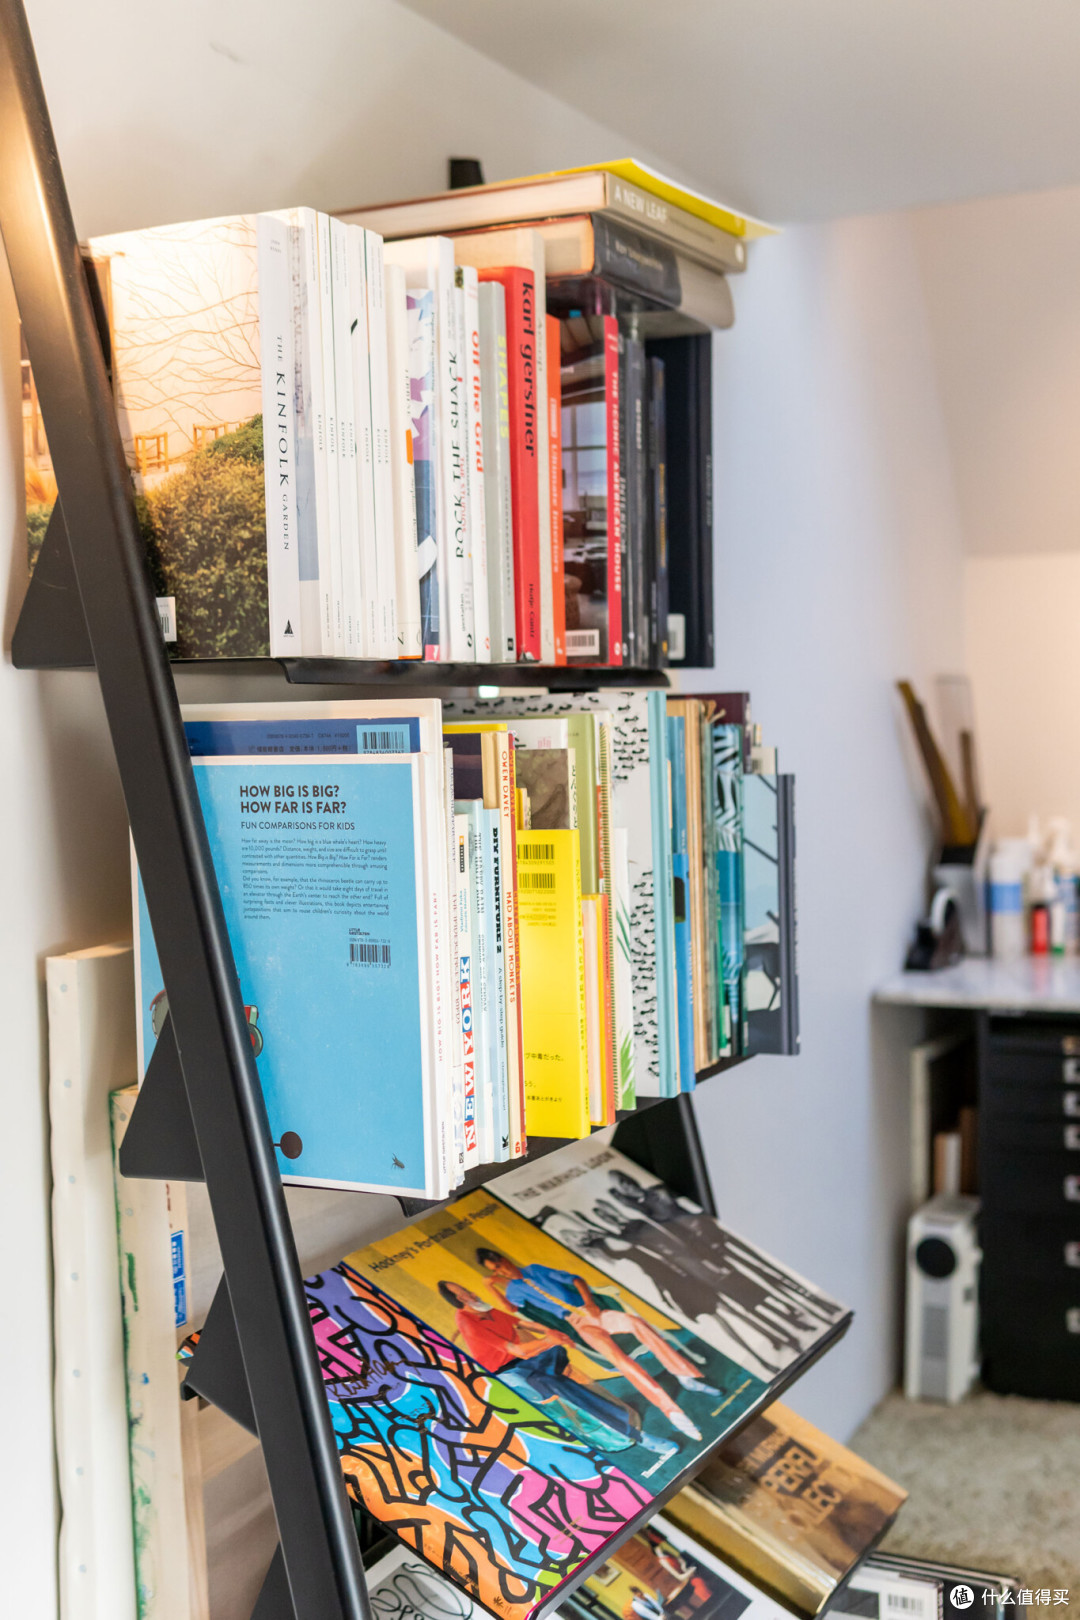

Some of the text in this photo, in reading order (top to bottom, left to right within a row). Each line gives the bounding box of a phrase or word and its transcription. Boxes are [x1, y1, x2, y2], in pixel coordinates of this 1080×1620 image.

[615, 184, 667, 224] A NEW LEAF
[498, 336, 509, 438] SHAPES
[520, 282, 537, 457] karl gerstner
[471, 331, 485, 473] Off the Grid
[276, 336, 290, 550] THE KINFOLK GARDEN
[448, 352, 464, 558] ROCK THE SHACK
[612, 404, 620, 455] ICONIC
[613, 462, 621, 538] AMERICAN
[239, 784, 340, 798] HOW BIG IS BIG?
[240, 801, 347, 814] HOW FAR IS FAR?
[501, 750, 511, 818] OWEN DAVEY
[241, 821, 356, 831] FUN COMPARISONS FOR KIDS
[493, 856, 502, 943] FURNITURE
[496, 945, 502, 954] 2
[506, 916, 514, 950] ABOUT
[498, 967, 504, 976] A
[508, 954, 516, 1004] MONKEYS
[460, 957, 477, 1152] NEW YORK
[367, 1245, 421, 1273] Hockney's
